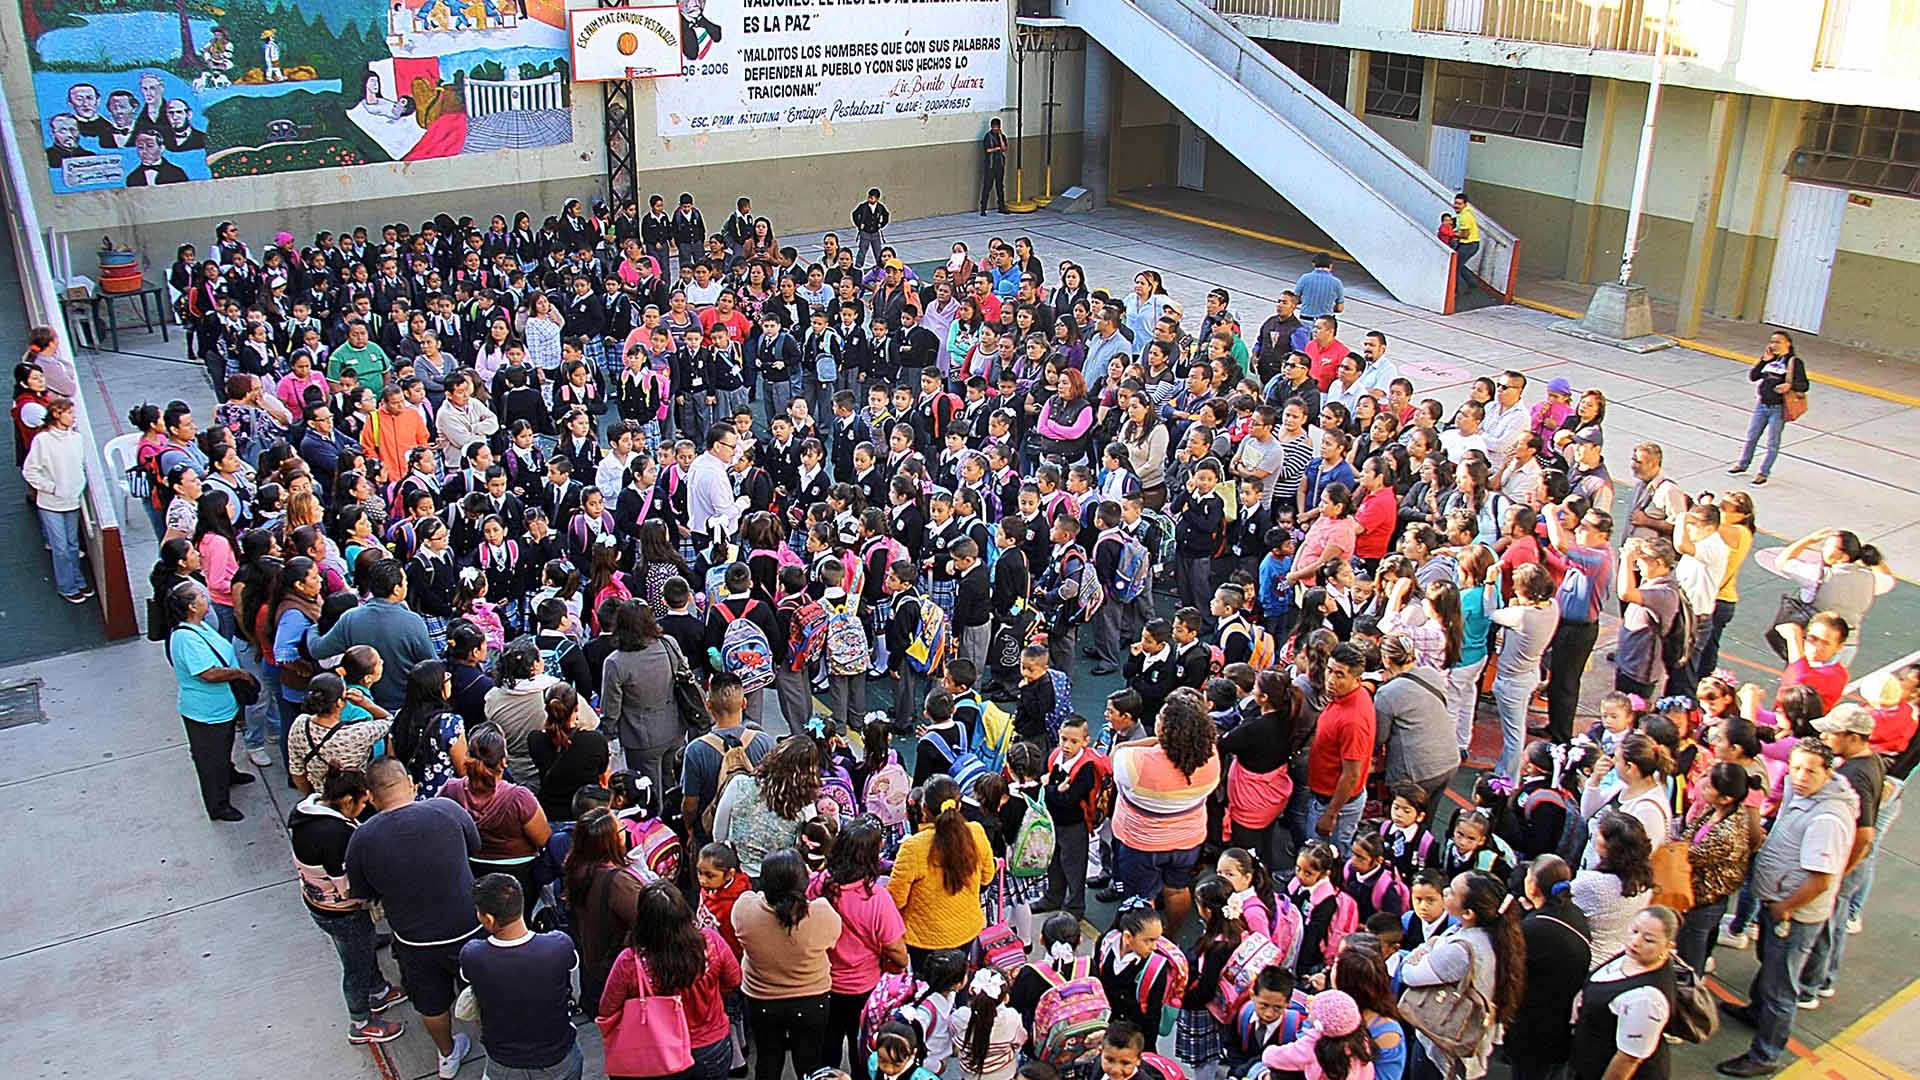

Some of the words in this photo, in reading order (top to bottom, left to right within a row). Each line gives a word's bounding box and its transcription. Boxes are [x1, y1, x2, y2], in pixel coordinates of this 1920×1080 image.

[616, 12, 644, 25] ENRIQUE
[743, 16, 760, 34] ES
[763, 15, 781, 33] LA
[801, 44, 822, 60] LOS
[824, 43, 879, 59] HOMBRES
[881, 42, 903, 56] QUE
[904, 40, 926, 55] CON
[928, 39, 950, 53] SUS
[952, 37, 1001, 52] PALABRAS
[744, 65, 803, 82] DEFIENDEN
[804, 64, 819, 78] AL
[821, 61, 862, 77] PUEBLO
[895, 58, 914, 72] SUS
[916, 57, 952, 72] HECHOS
[955, 56, 968, 70] LO
[908, 73, 945, 99] Benito
